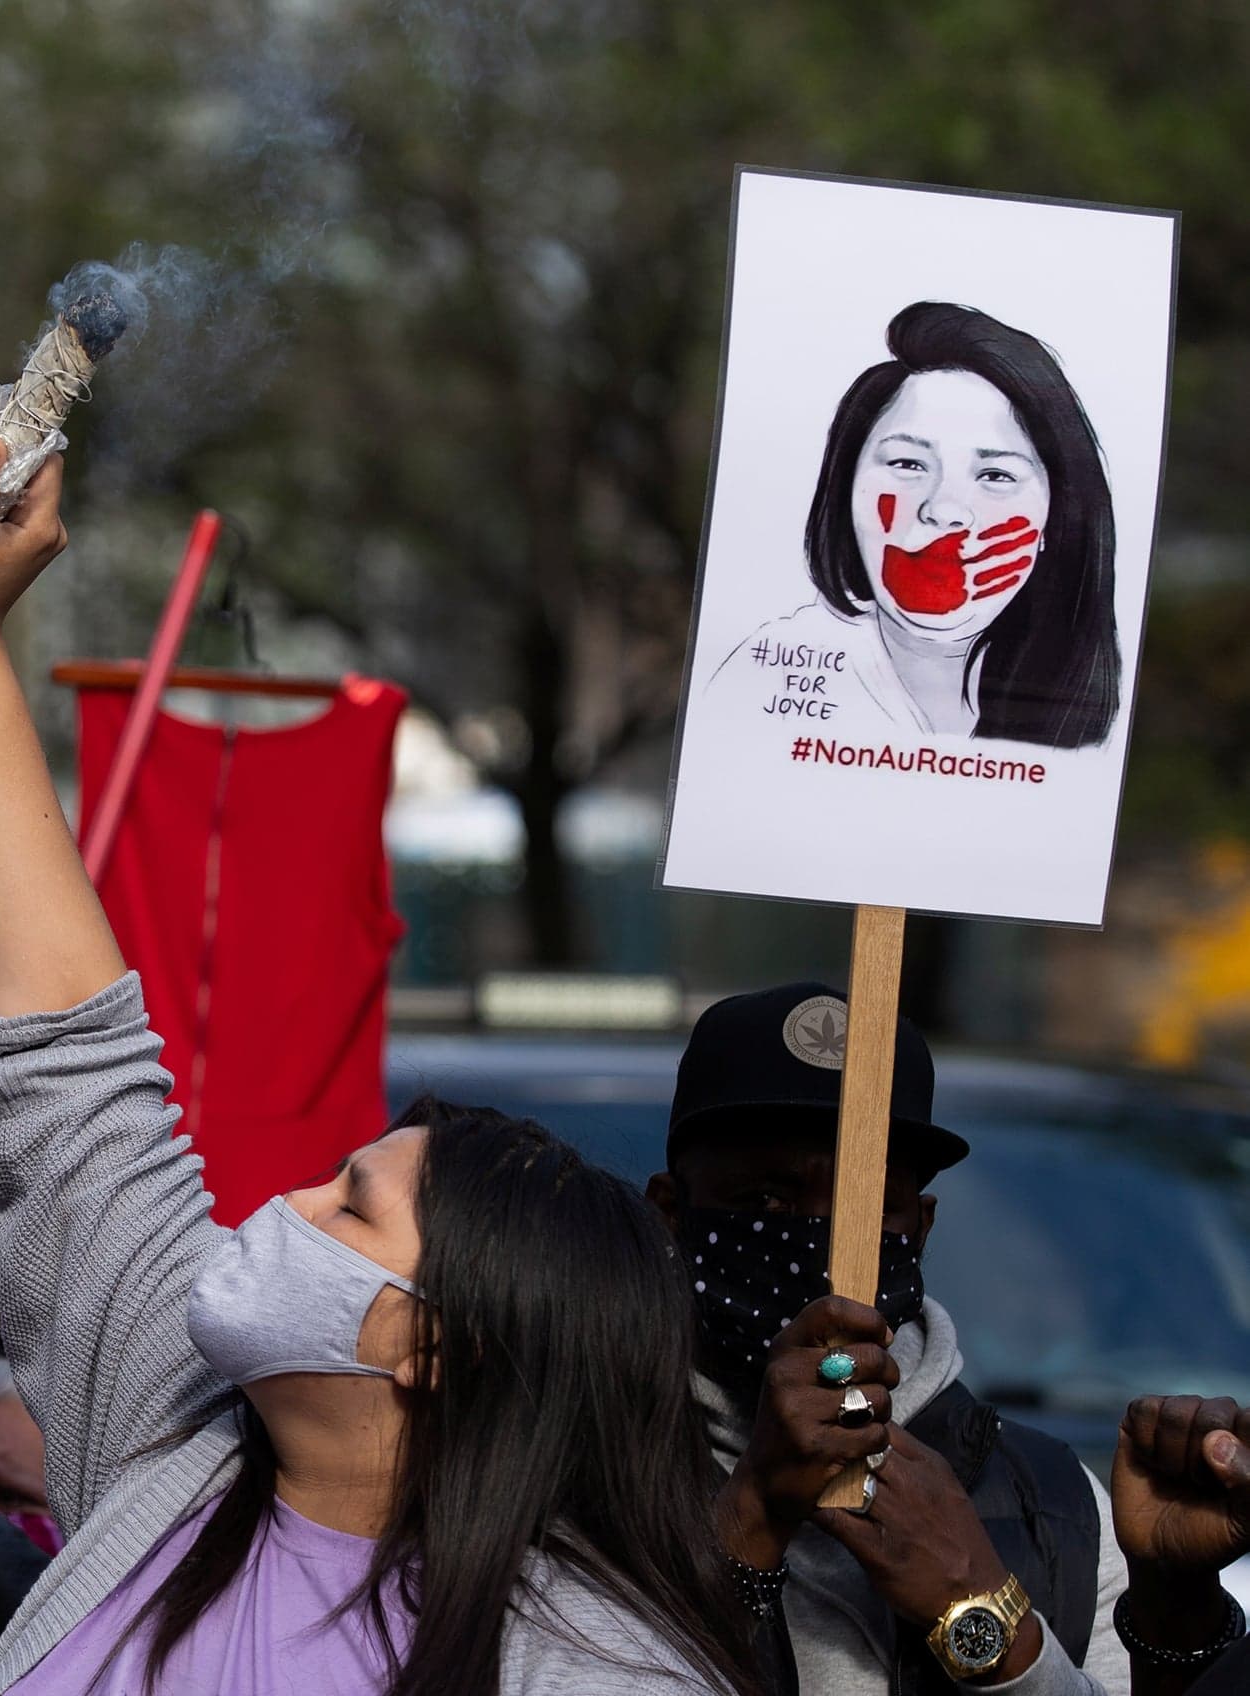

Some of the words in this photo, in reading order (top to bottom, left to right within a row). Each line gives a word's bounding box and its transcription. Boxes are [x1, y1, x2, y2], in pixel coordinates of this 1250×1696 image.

[787, 675, 826, 695] FOR
[763, 695, 838, 720] JOYCE
[791, 737, 1046, 783] #NonAuRacisme
